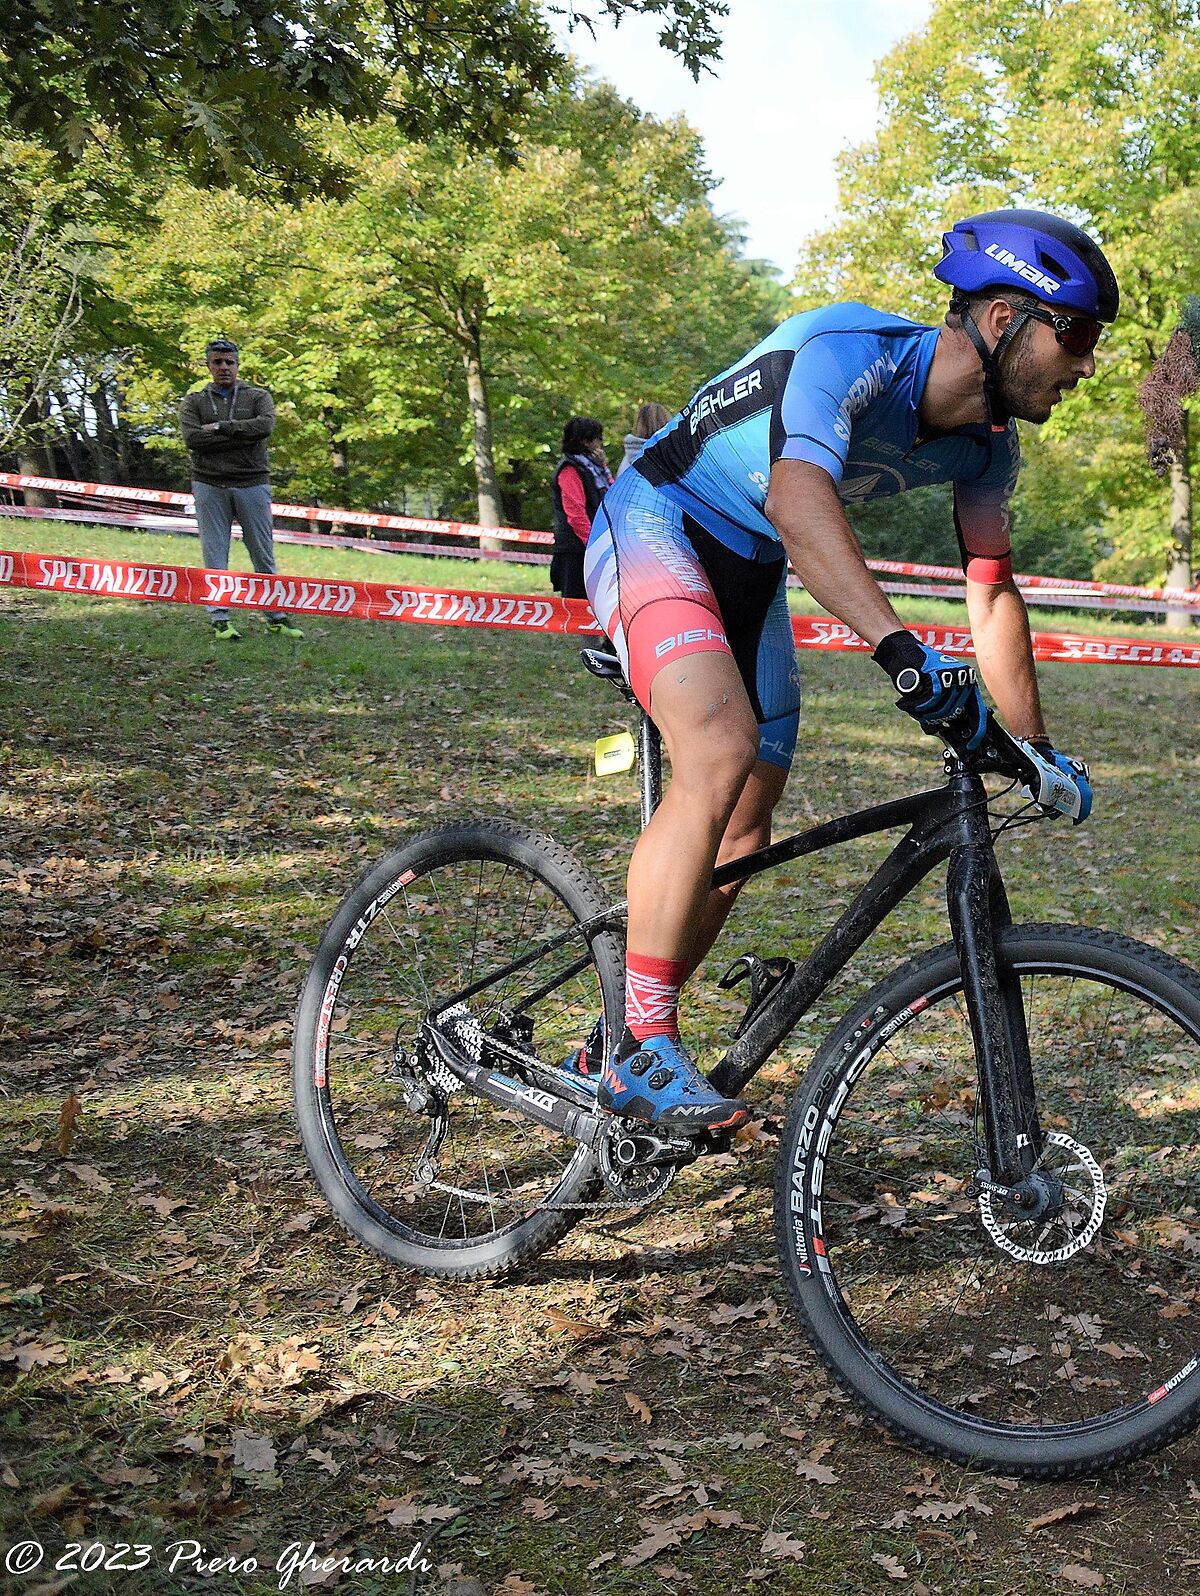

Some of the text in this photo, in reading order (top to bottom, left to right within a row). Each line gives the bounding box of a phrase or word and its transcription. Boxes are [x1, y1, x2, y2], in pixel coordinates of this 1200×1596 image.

[36, 558, 178, 598] SPECIALIZED
[200, 573, 356, 613] SPECIALIZED
[379, 589, 554, 627] SPECIALIZED
[791, 1104, 821, 1214] BARZO
[1165, 1358, 1198, 1392] NOTUBES
